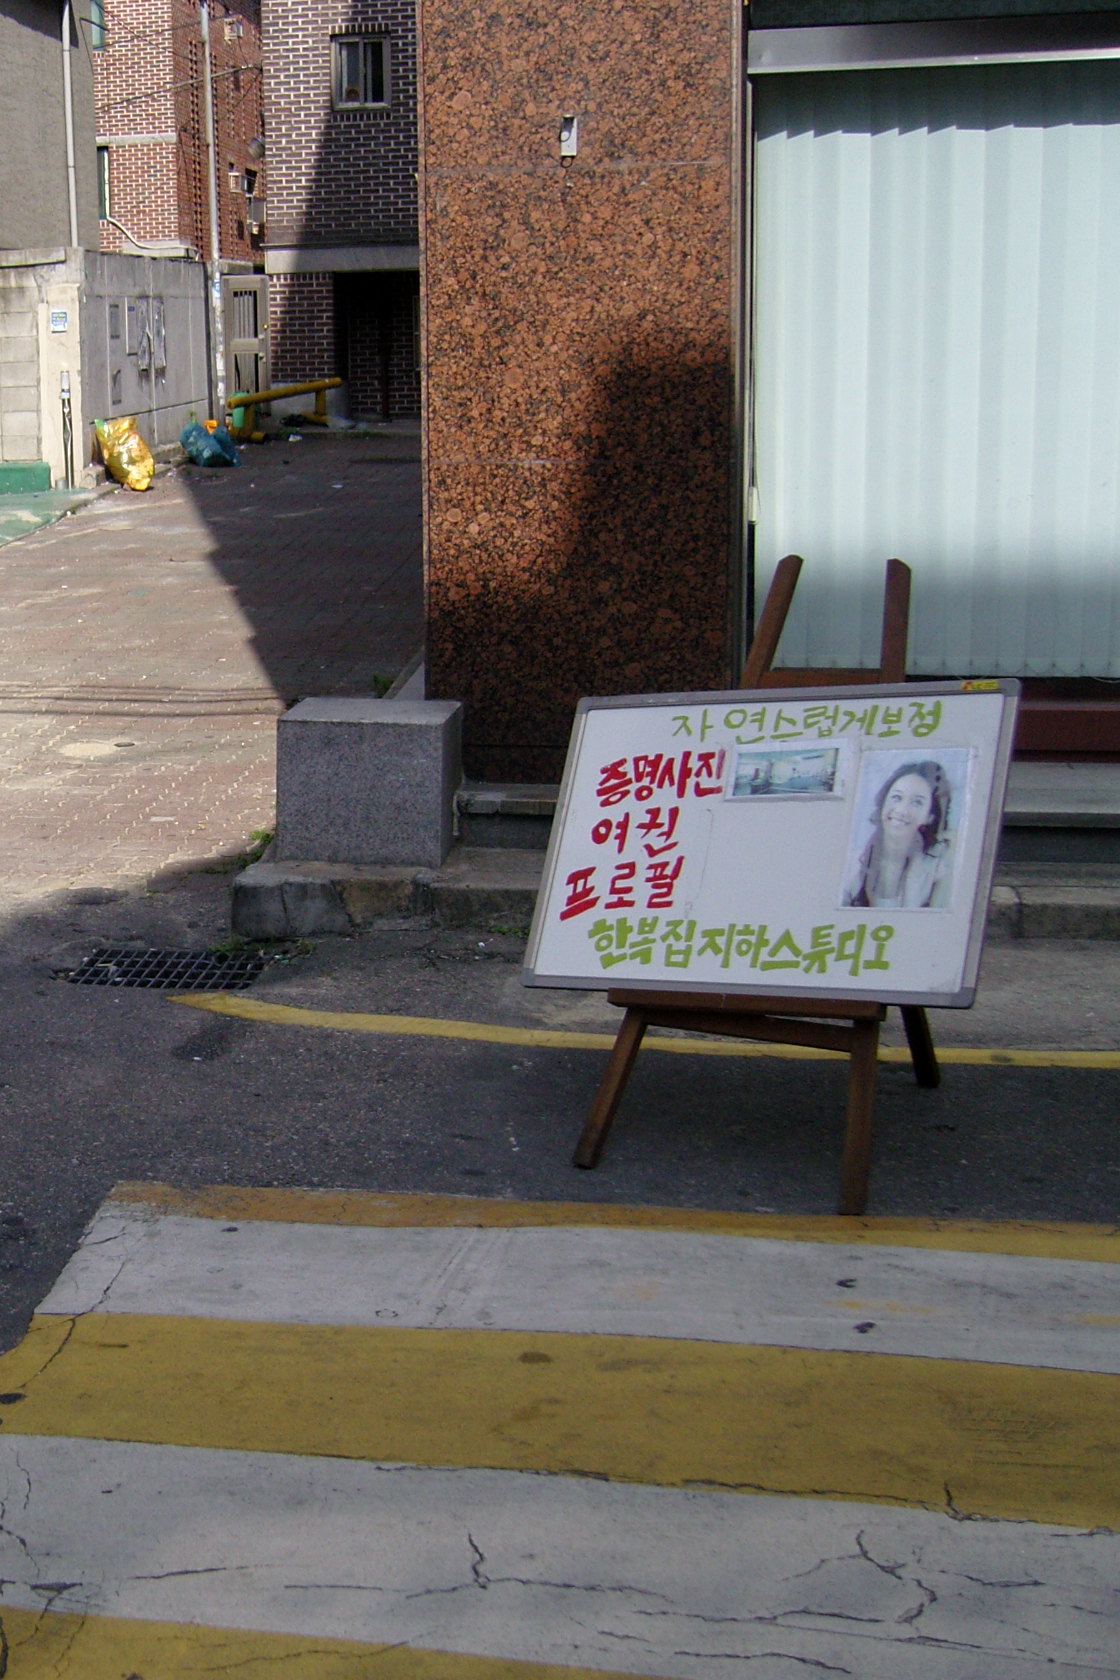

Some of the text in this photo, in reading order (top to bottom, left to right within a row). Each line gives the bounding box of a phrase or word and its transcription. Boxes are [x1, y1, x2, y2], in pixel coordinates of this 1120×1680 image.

[595, 749, 727, 808] 증명사진
[591, 806, 680, 858] 여권
[559, 855, 685, 921] 프로필
